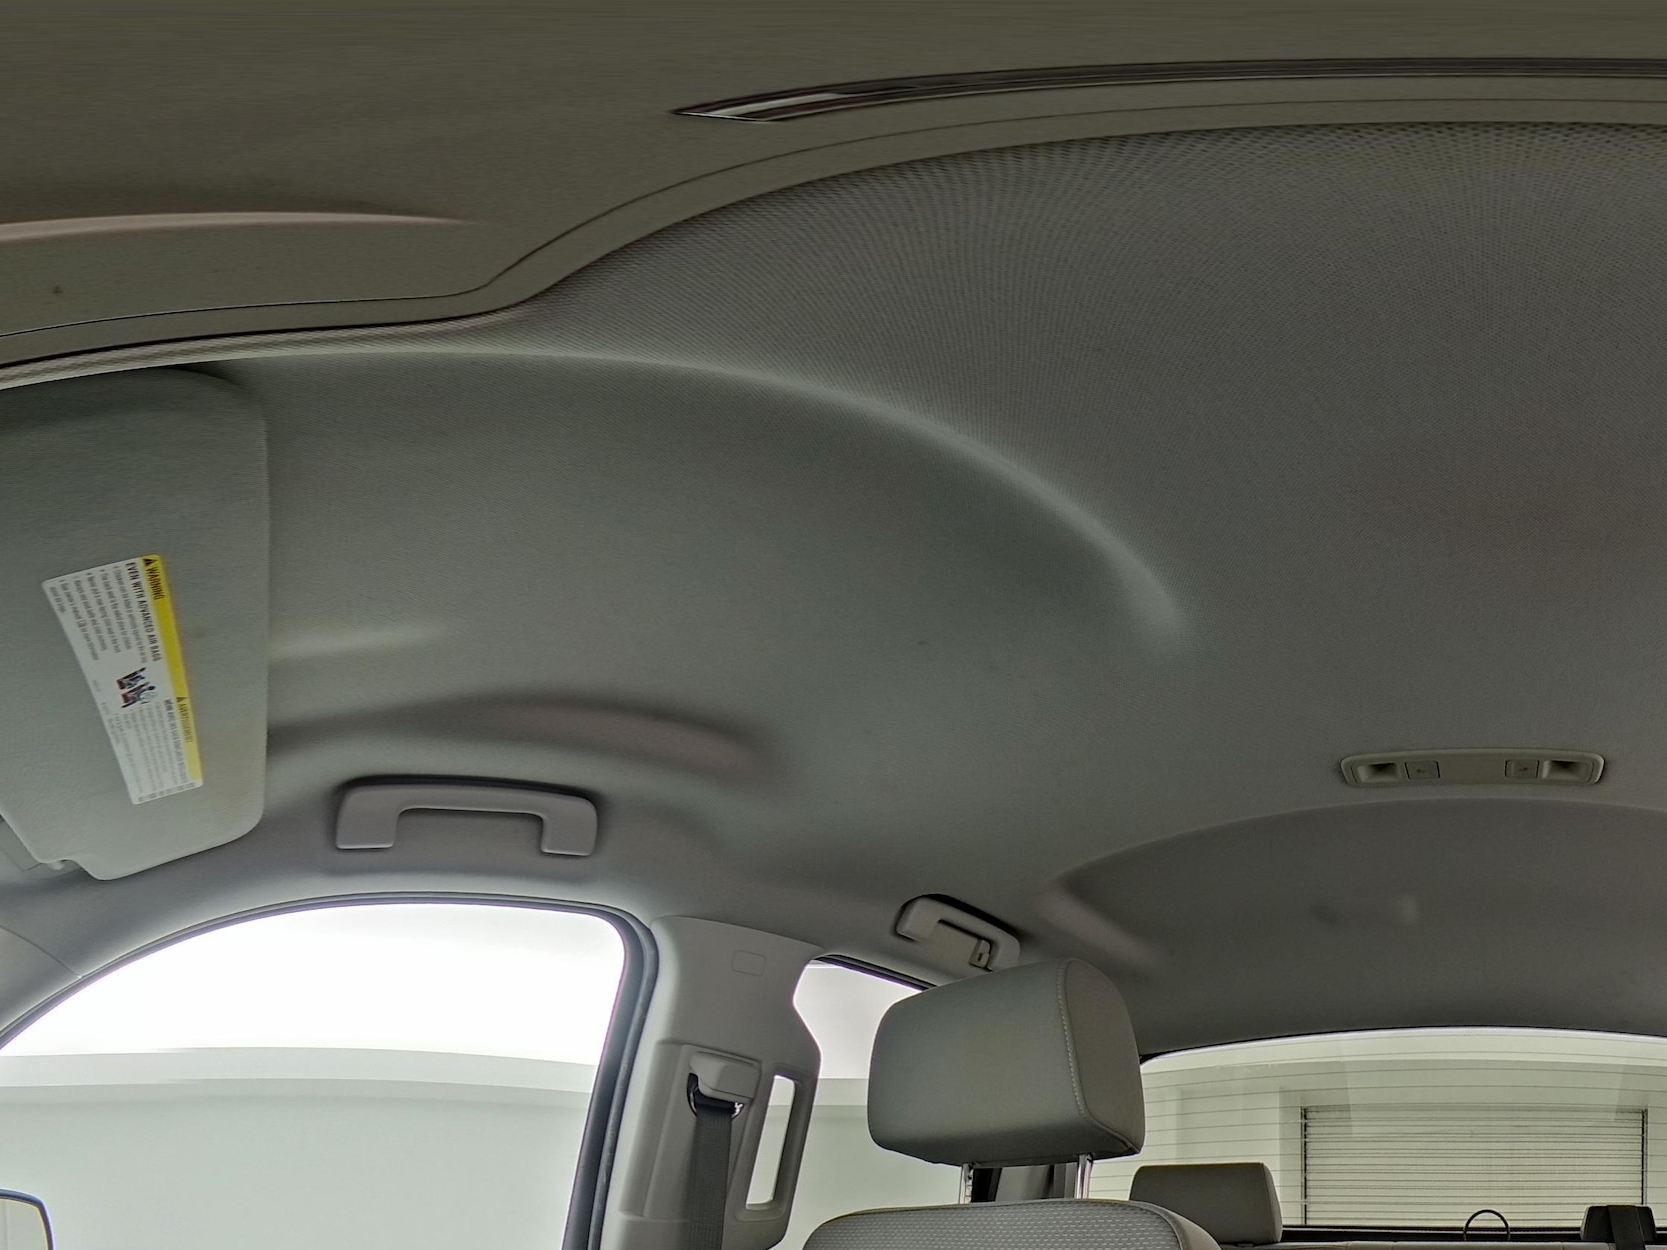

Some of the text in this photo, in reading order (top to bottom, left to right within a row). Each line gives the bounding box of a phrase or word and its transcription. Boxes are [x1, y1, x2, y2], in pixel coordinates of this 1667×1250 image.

[126, 562, 141, 580] EVEN
[147, 567, 164, 600] WARNING
[132, 581, 145, 598] WITH
[137, 600, 155, 632] ADVANCED
